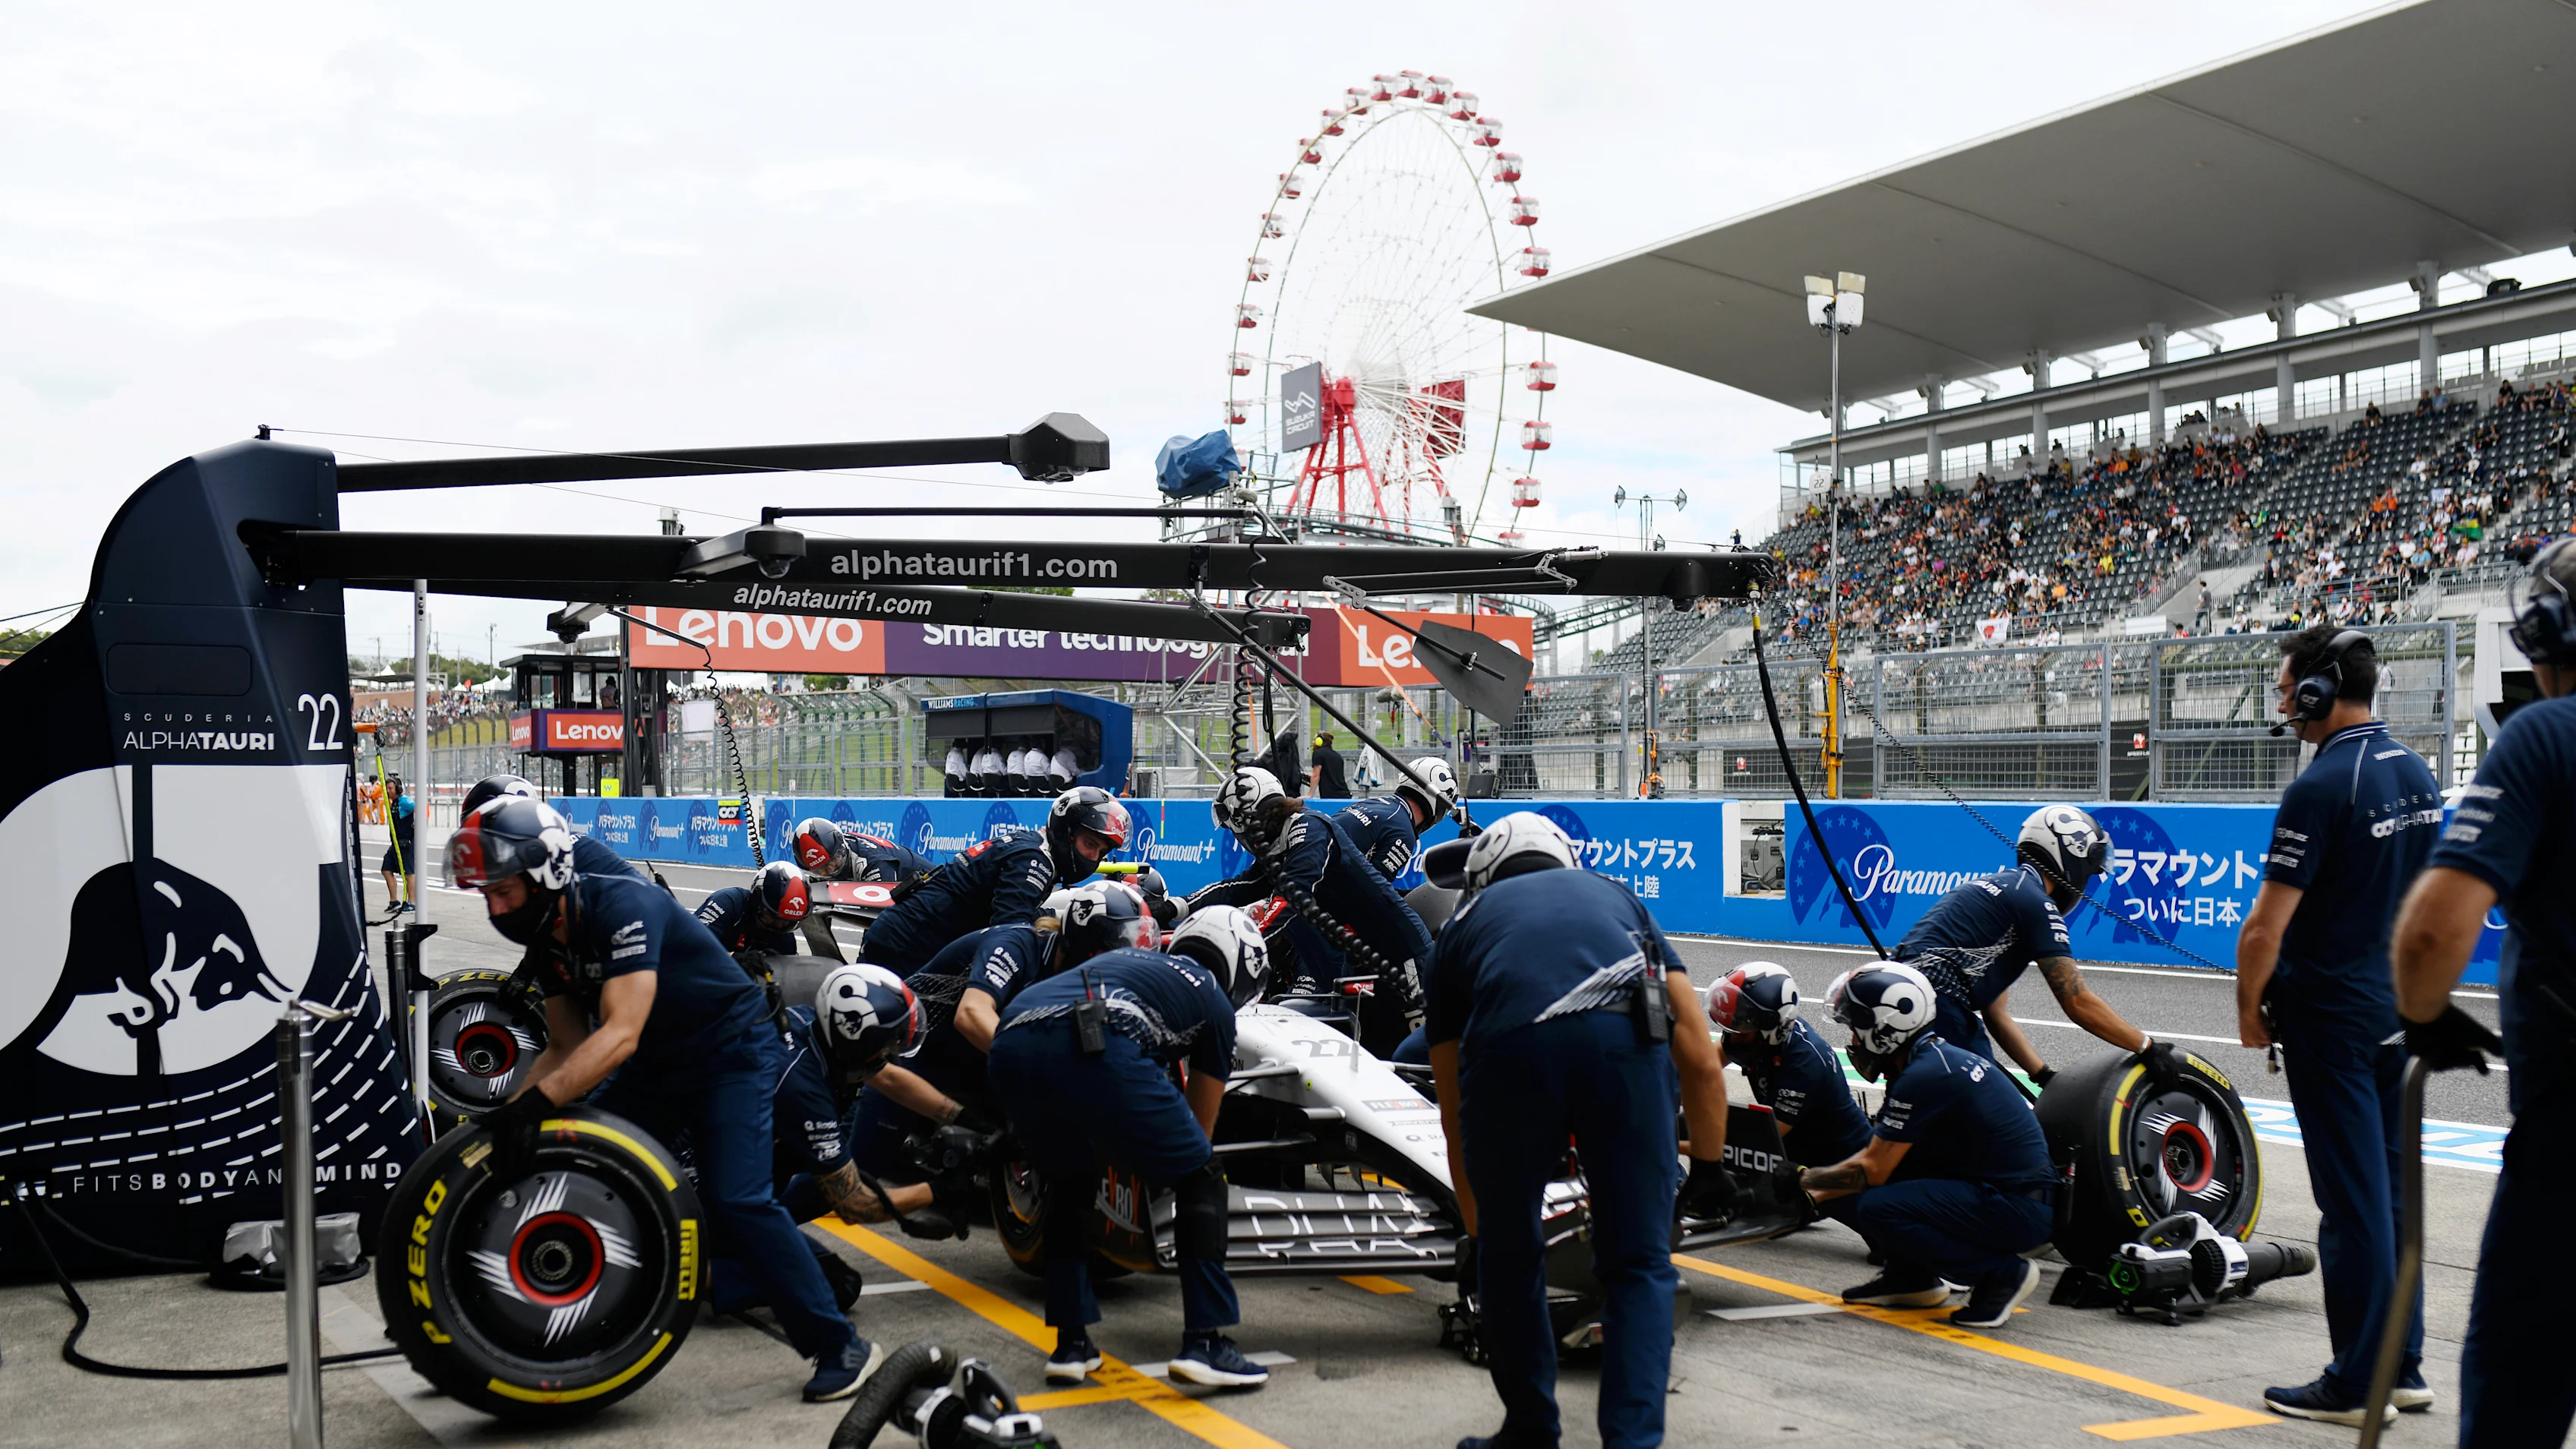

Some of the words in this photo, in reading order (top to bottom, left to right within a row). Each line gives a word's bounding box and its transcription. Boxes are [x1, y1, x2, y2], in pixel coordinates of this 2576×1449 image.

[1286, 411, 1315, 426] SUZUKA
[1286, 419, 1315, 435] CIRCUIT
[1814, 478, 1824, 488] 22
[831, 550, 1117, 579] alphataurif1.com
[733, 583, 932, 616] alphataurif1.com
[646, 606, 863, 652] Lenovo
[928, 699, 953, 709] WILLIAMS
[954, 697, 974, 708] RACING
[124, 713, 273, 722] SCUDERIA
[298, 693, 343, 750] 22
[512, 725, 530, 742] Lenovo
[556, 721, 623, 740] Lenov
[123, 731, 274, 750] ALPHATAURI
[598, 814, 636, 829] パラマウントプラス
[649, 816, 684, 841] Paramount+
[917, 822, 977, 855] Paramount+
[1135, 827, 1215, 864] Paramount+
[810, 854, 826, 867] ORLEN
[1264, 901, 1282, 921] ORLEN
[2124, 896, 2256, 927] ついに日本
[1002, 952, 1019, 973] Rapid
[1291, 1039, 1362, 1058] 22
[74, 1175, 142, 1192] FITS
[152, 1170, 235, 1190] BODY
[245, 1167, 283, 1185] AN
[315, 1162, 402, 1182] MIND
